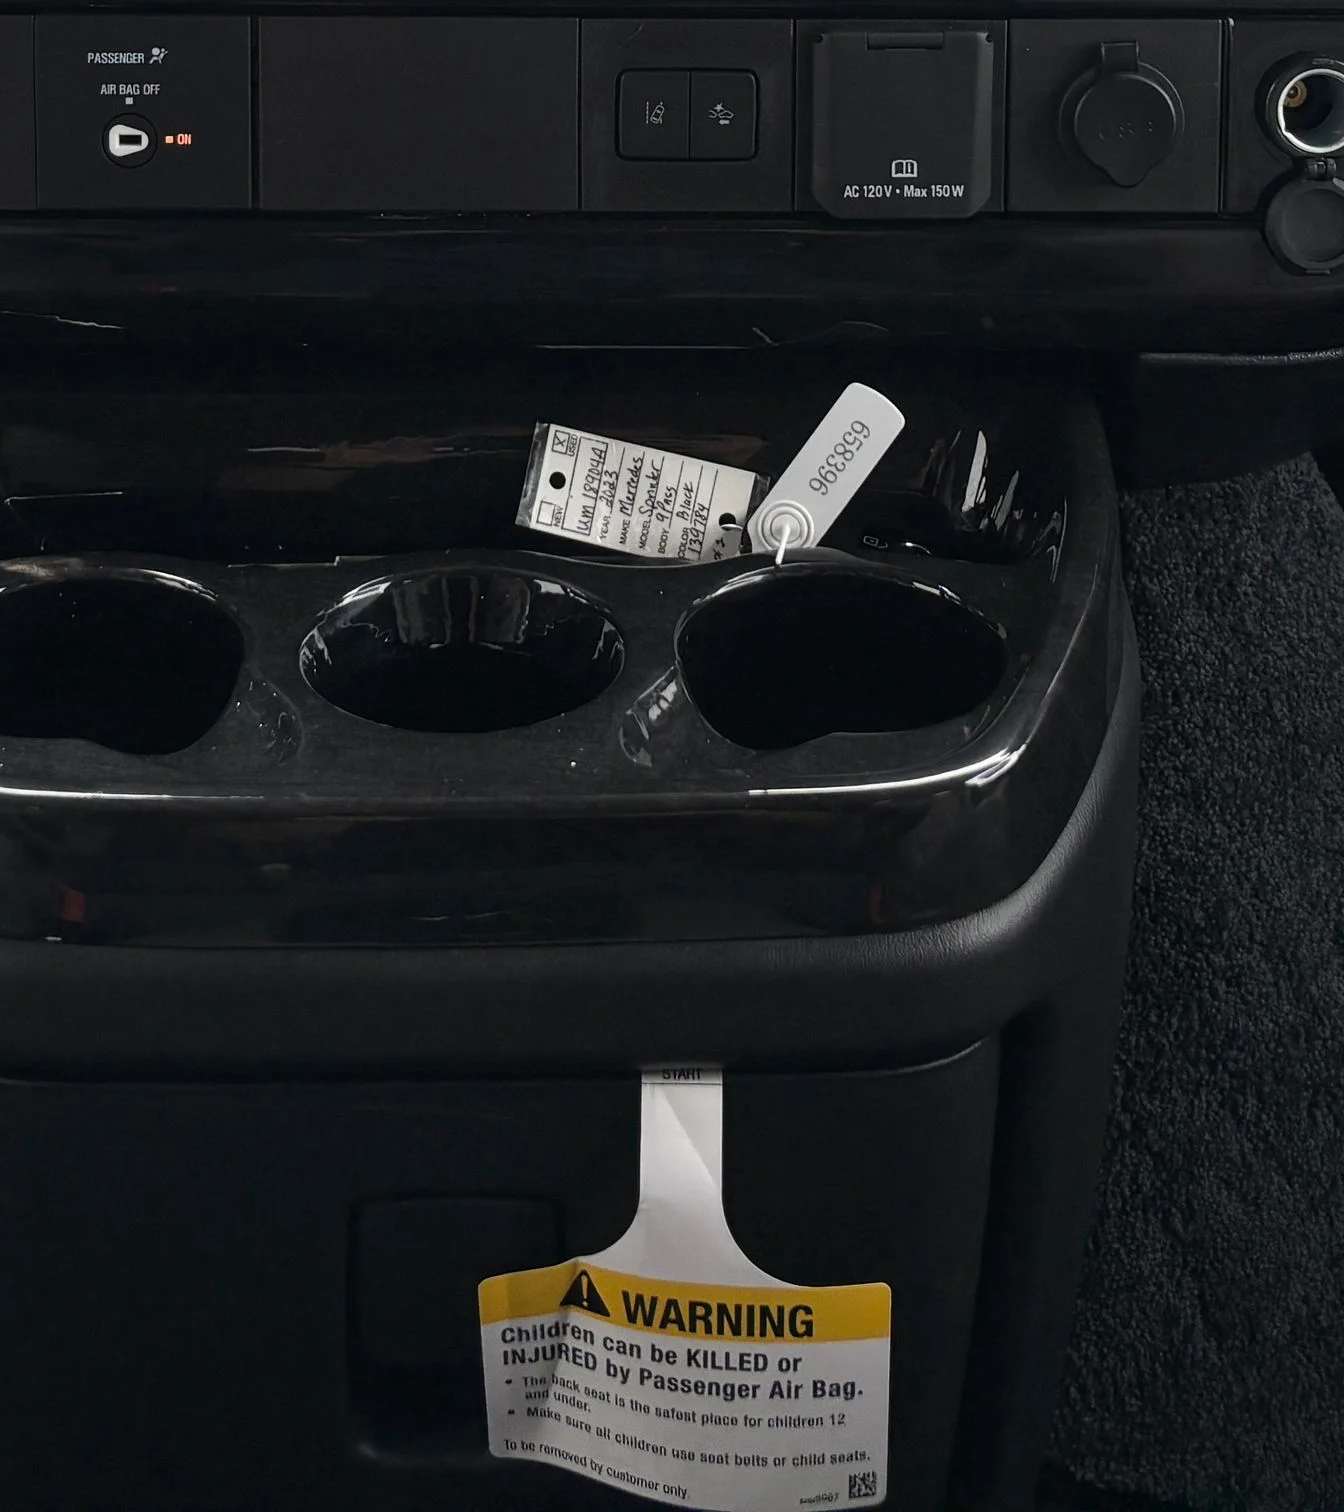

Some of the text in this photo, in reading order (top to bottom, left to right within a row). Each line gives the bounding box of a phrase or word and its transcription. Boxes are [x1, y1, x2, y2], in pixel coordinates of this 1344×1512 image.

[87, 52, 144, 64] PASSENGER
[100, 84, 160, 95] AIR BAG OFF
[177, 133, 192, 145] ON
[843, 185, 860, 198] AC
[903, 184, 927, 198] Max
[567, 433, 577, 457] USED
[808, 420, 872, 496] 658396
[553, 505, 564, 527] NEW
[599, 469, 617, 540] YEAR 2023
[618, 456, 643, 545] MAKE Mercedes
[676, 481, 694, 559] COLOR Black
[639, 517, 651, 549] MODEL
[658, 529, 669, 554] BODY
[622, 1290, 814, 1338] WARNING
[501, 1321, 802, 1373] Children can be KILLED or
[503, 1343, 864, 1402] INJURED by Passenger Air Bag.
[522, 1373, 846, 1429] The back seat is the safest place for children 12
[525, 1389, 591, 1413] and under.
[526, 1406, 871, 1468] Make sure all children use seat belts or child seats.
[503, 1439, 517, 1451] To
[521, 1440, 535, 1452] be
[539, 1443, 587, 1468] removed
[590, 1458, 603, 1475] by
[606, 1466, 660, 1491] customer
